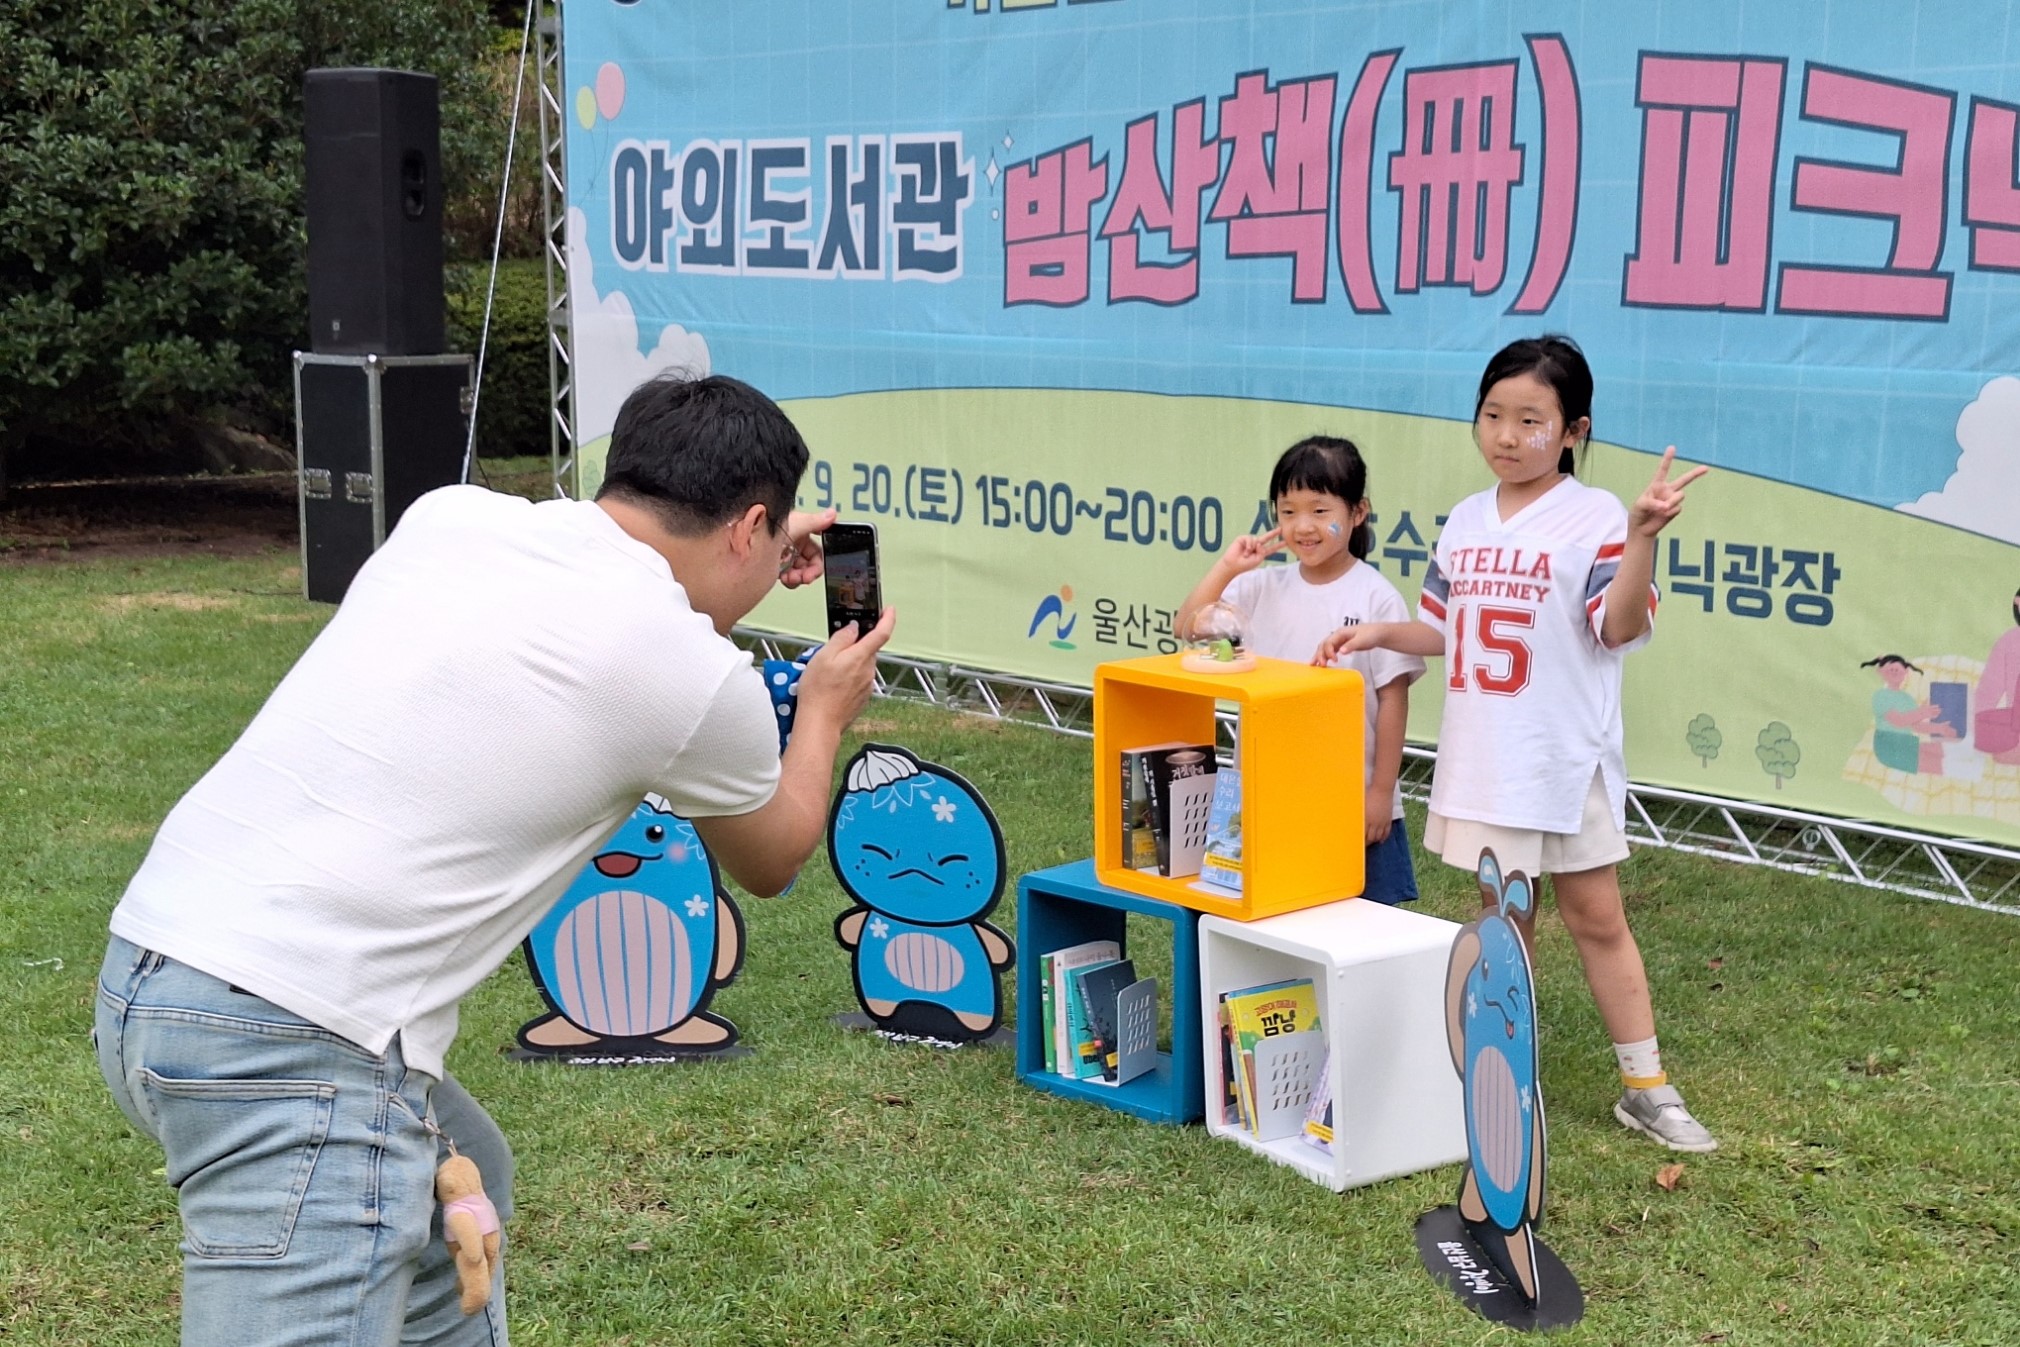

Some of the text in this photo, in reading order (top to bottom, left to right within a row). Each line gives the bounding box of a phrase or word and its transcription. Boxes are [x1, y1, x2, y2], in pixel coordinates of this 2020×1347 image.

[612, 135, 972, 280] 야외도서관
[1003, 33, 1582, 315] 밤산책(冊)
[853, 462, 963, 525] 20.(토)
[976, 475, 1223, 552] 15:00~20:00
[1652, 537, 1841, 627] 닉광장
[1450, 579, 1552, 604] CCARTNEY
[1448, 603, 1536, 698] 15
